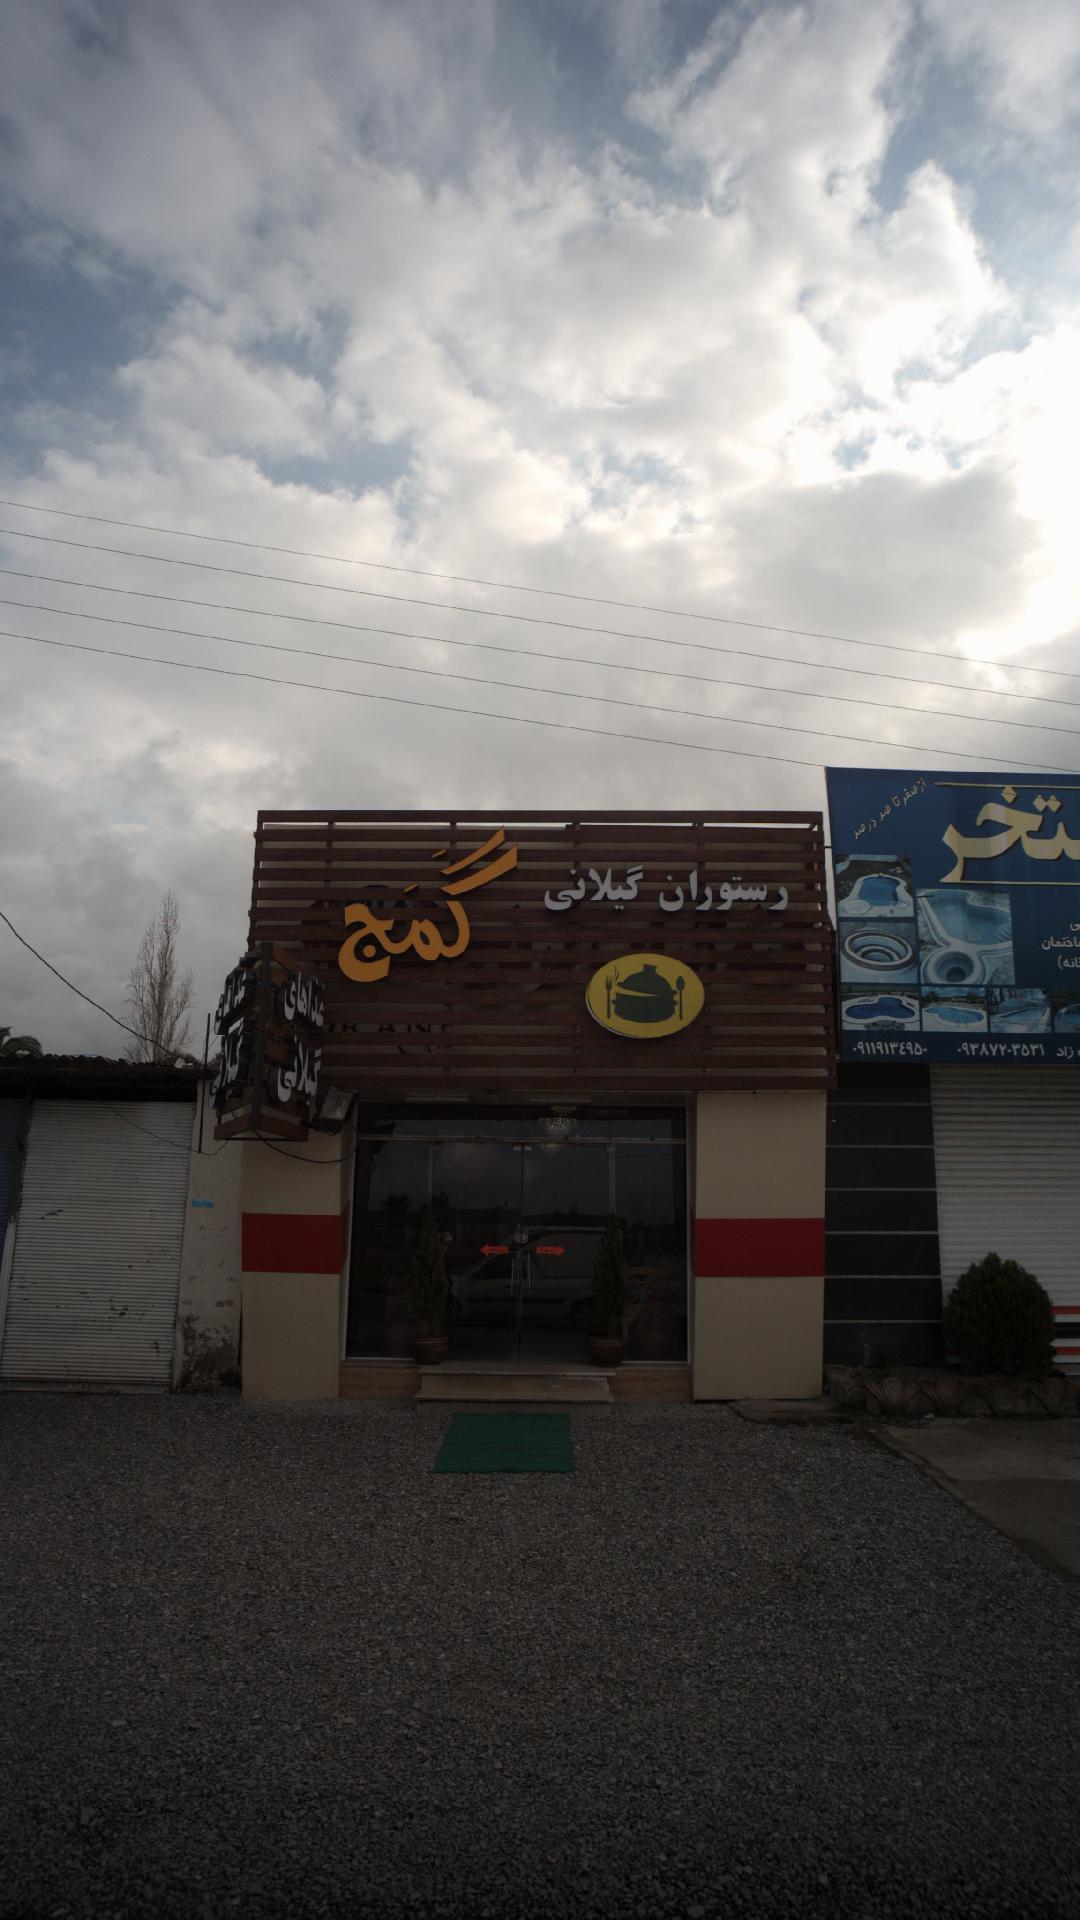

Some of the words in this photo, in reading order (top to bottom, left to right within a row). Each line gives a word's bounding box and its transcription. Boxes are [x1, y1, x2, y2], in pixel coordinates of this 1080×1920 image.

[544, 865, 644, 912] گیلانی
[658, 869, 789, 912] رستوران
[284, 970, 326, 1027] غذاهای
[277, 1035, 322, 1106] گیلانی
